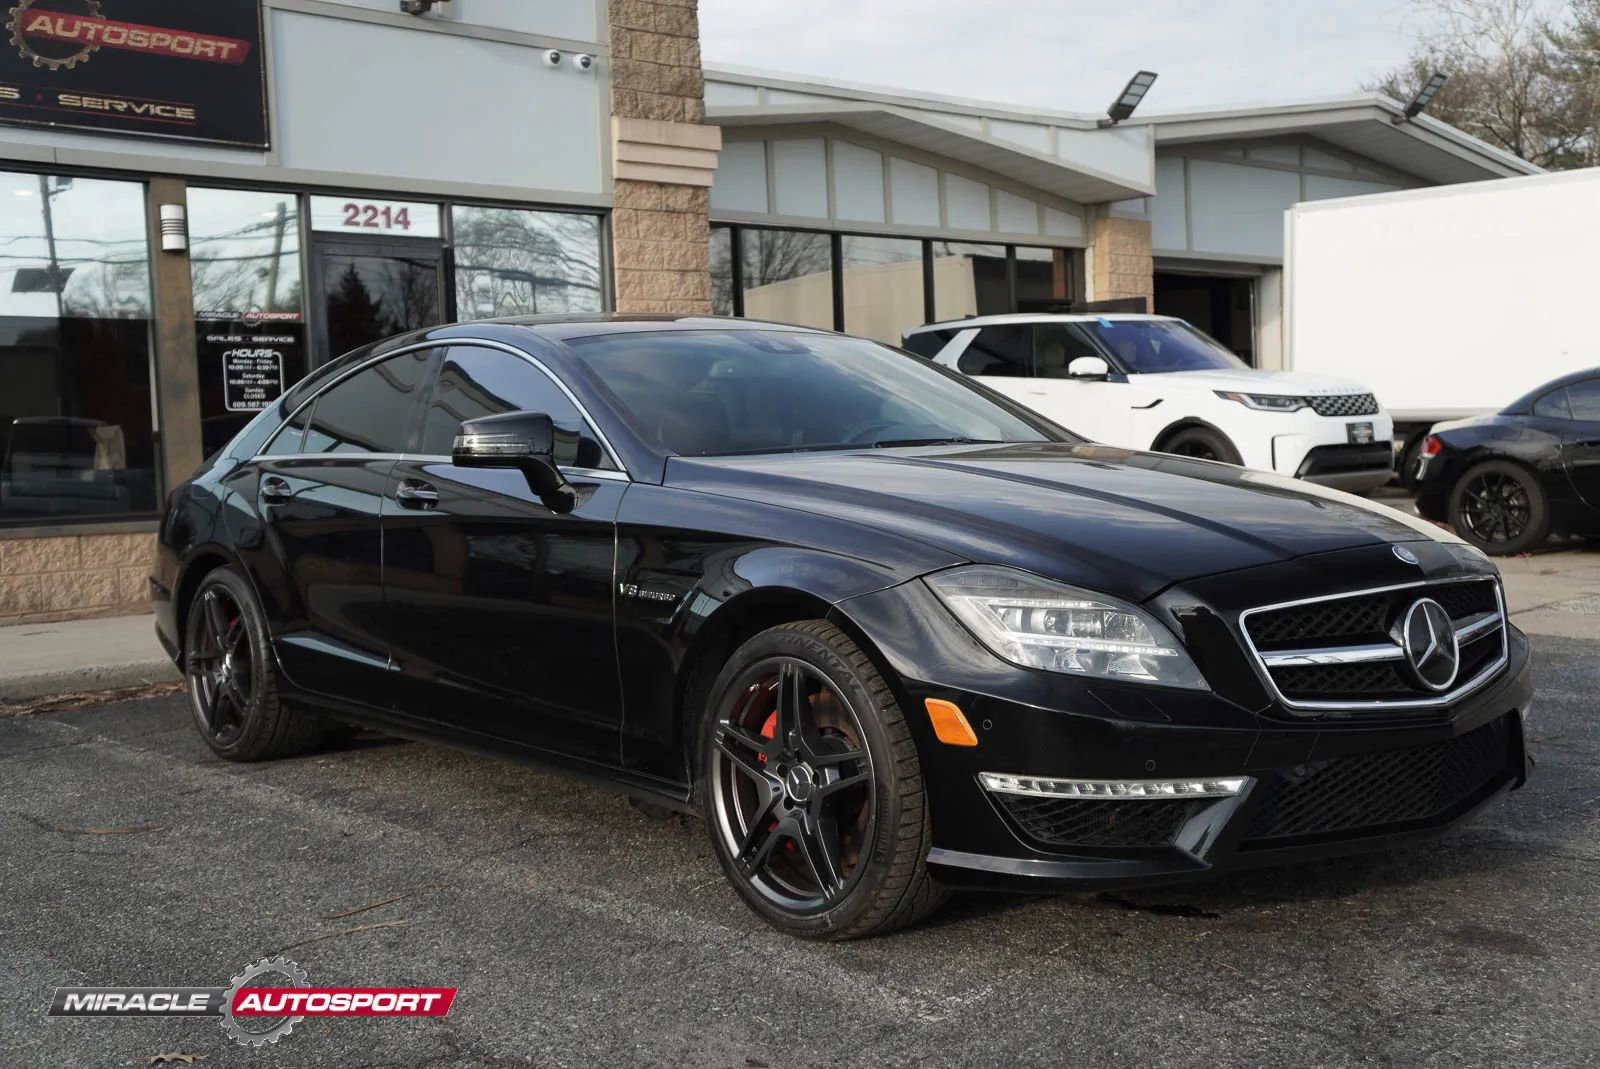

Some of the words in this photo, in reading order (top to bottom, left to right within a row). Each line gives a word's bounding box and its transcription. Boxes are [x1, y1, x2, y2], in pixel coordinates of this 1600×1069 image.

[26, 15, 238, 60] AUTOSPORT
[57, 93, 196, 120] SERVICE
[343, 203, 410, 230] 2214
[199, 311, 239, 319] MIRACLE
[245, 312, 300, 320] AUTOSPORT
[251, 335, 294, 343] SERVICE
[231, 348, 274, 358] HOURS
